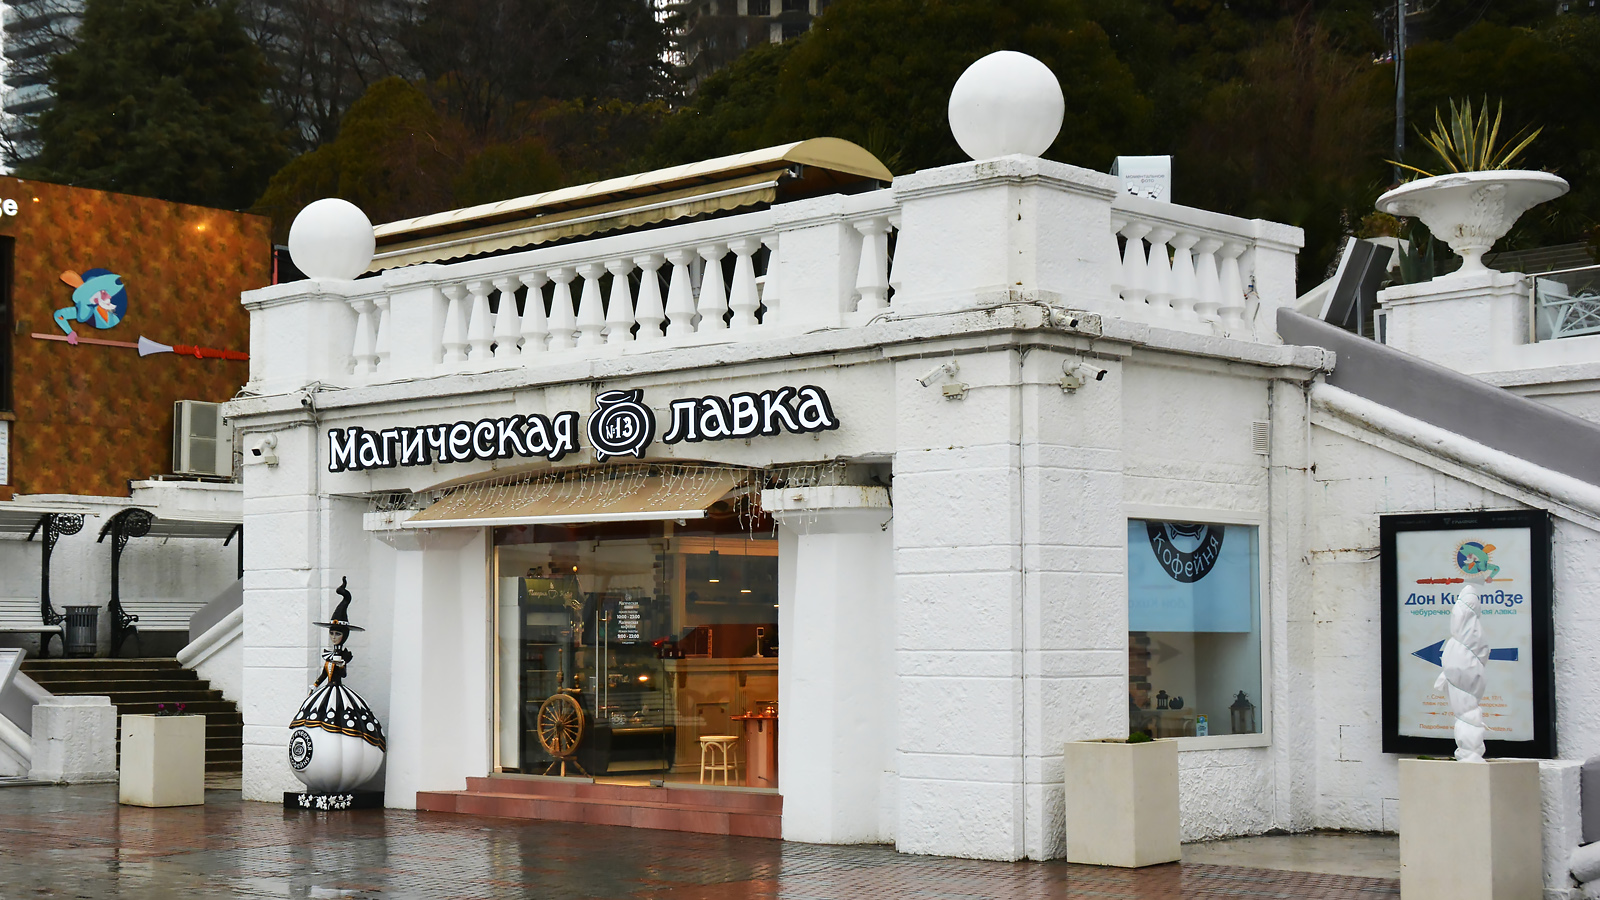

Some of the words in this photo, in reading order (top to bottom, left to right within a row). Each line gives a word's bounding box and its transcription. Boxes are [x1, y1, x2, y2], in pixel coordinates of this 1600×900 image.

[329, 412, 577, 470] Магическая
[665, 387, 833, 441] лавка
[1405, 593, 1435, 605] Дон
